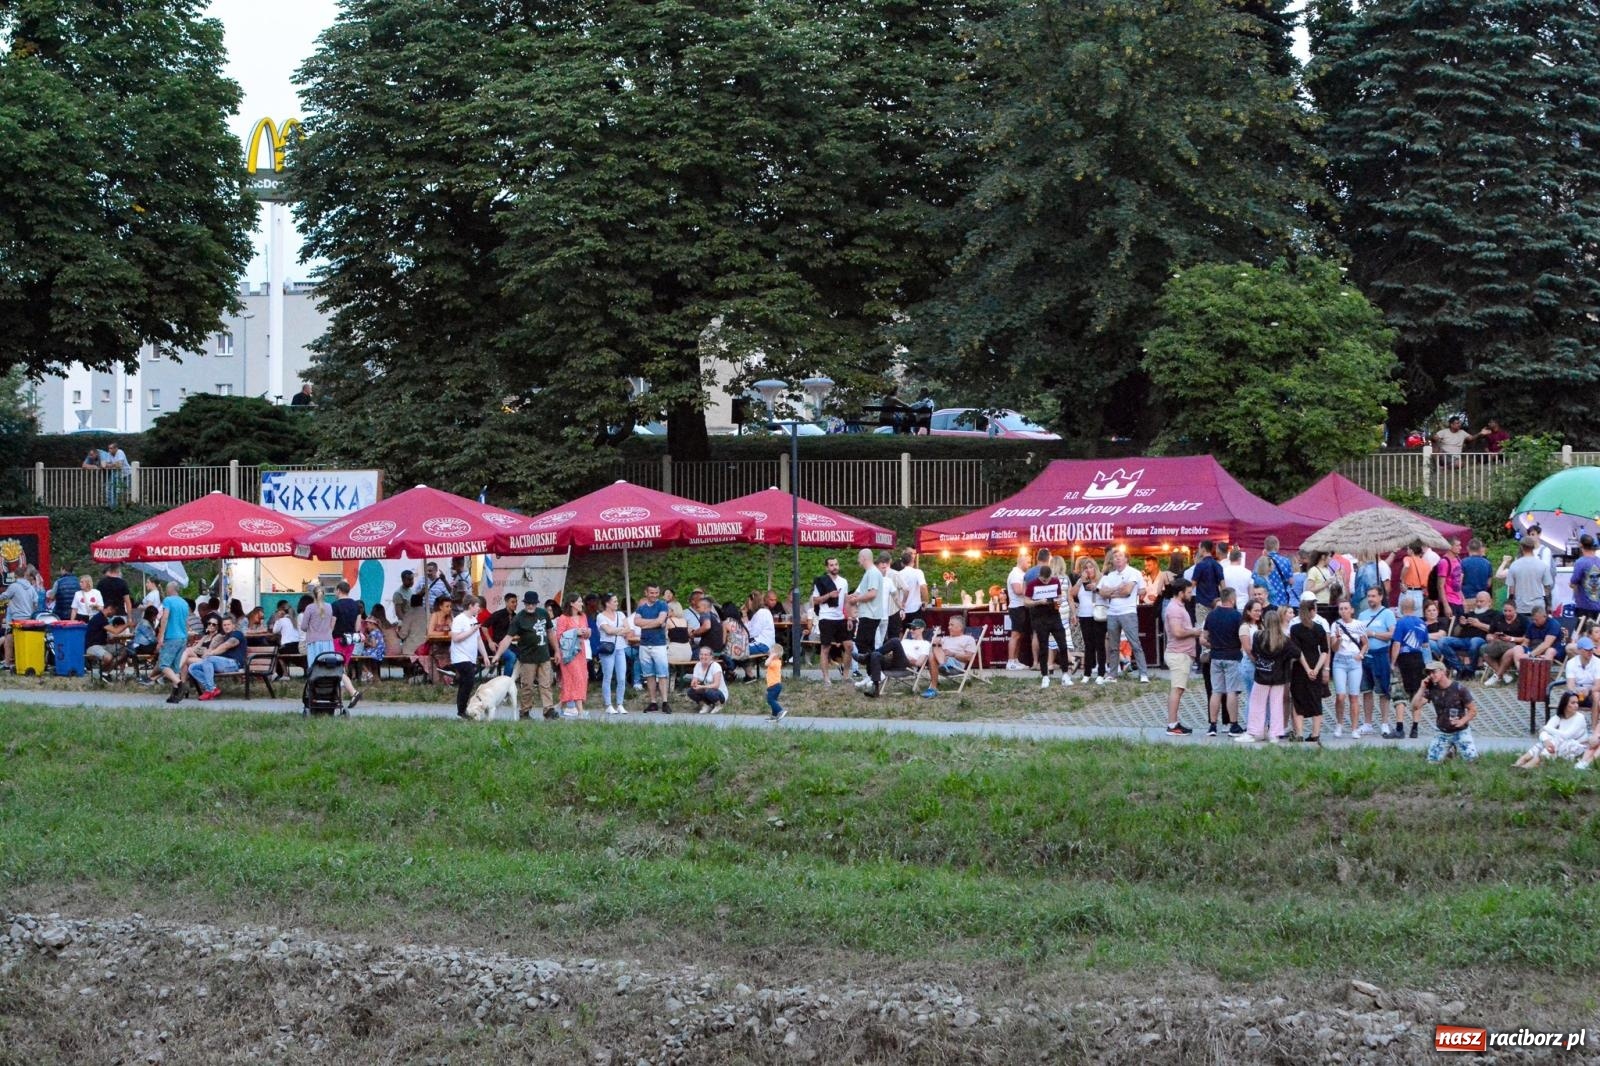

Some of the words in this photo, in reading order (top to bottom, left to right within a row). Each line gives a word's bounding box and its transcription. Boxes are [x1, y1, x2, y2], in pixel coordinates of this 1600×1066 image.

[279, 485, 361, 511] GRECKA
[1134, 488, 1156, 497] 1567
[990, 507, 1050, 519] Browar
[1049, 503, 1127, 516] Zamkowy
[1127, 500, 1204, 514] Racibórz
[594, 525, 662, 542] RACIBORSKIE
[696, 522, 743, 536] RACIBORSKIE
[801, 530, 855, 542] RACIBORSKIE
[939, 533, 961, 542] Browar
[962, 531, 990, 541] Zamkowy
[991, 530, 1018, 539] Racibórz
[1029, 522, 1115, 543] RACIBORSKIE
[1126, 526, 1149, 535] Browar
[1150, 525, 1180, 536] Zamkowy
[1180, 525, 1209, 535] Racibórz
[509, 532, 558, 549] RACIBORSKIE
[146, 543, 221, 556] RACIBORSKIE
[331, 546, 387, 559] RACIBORSKIE
[424, 540, 488, 556] RACIBORSKIE
